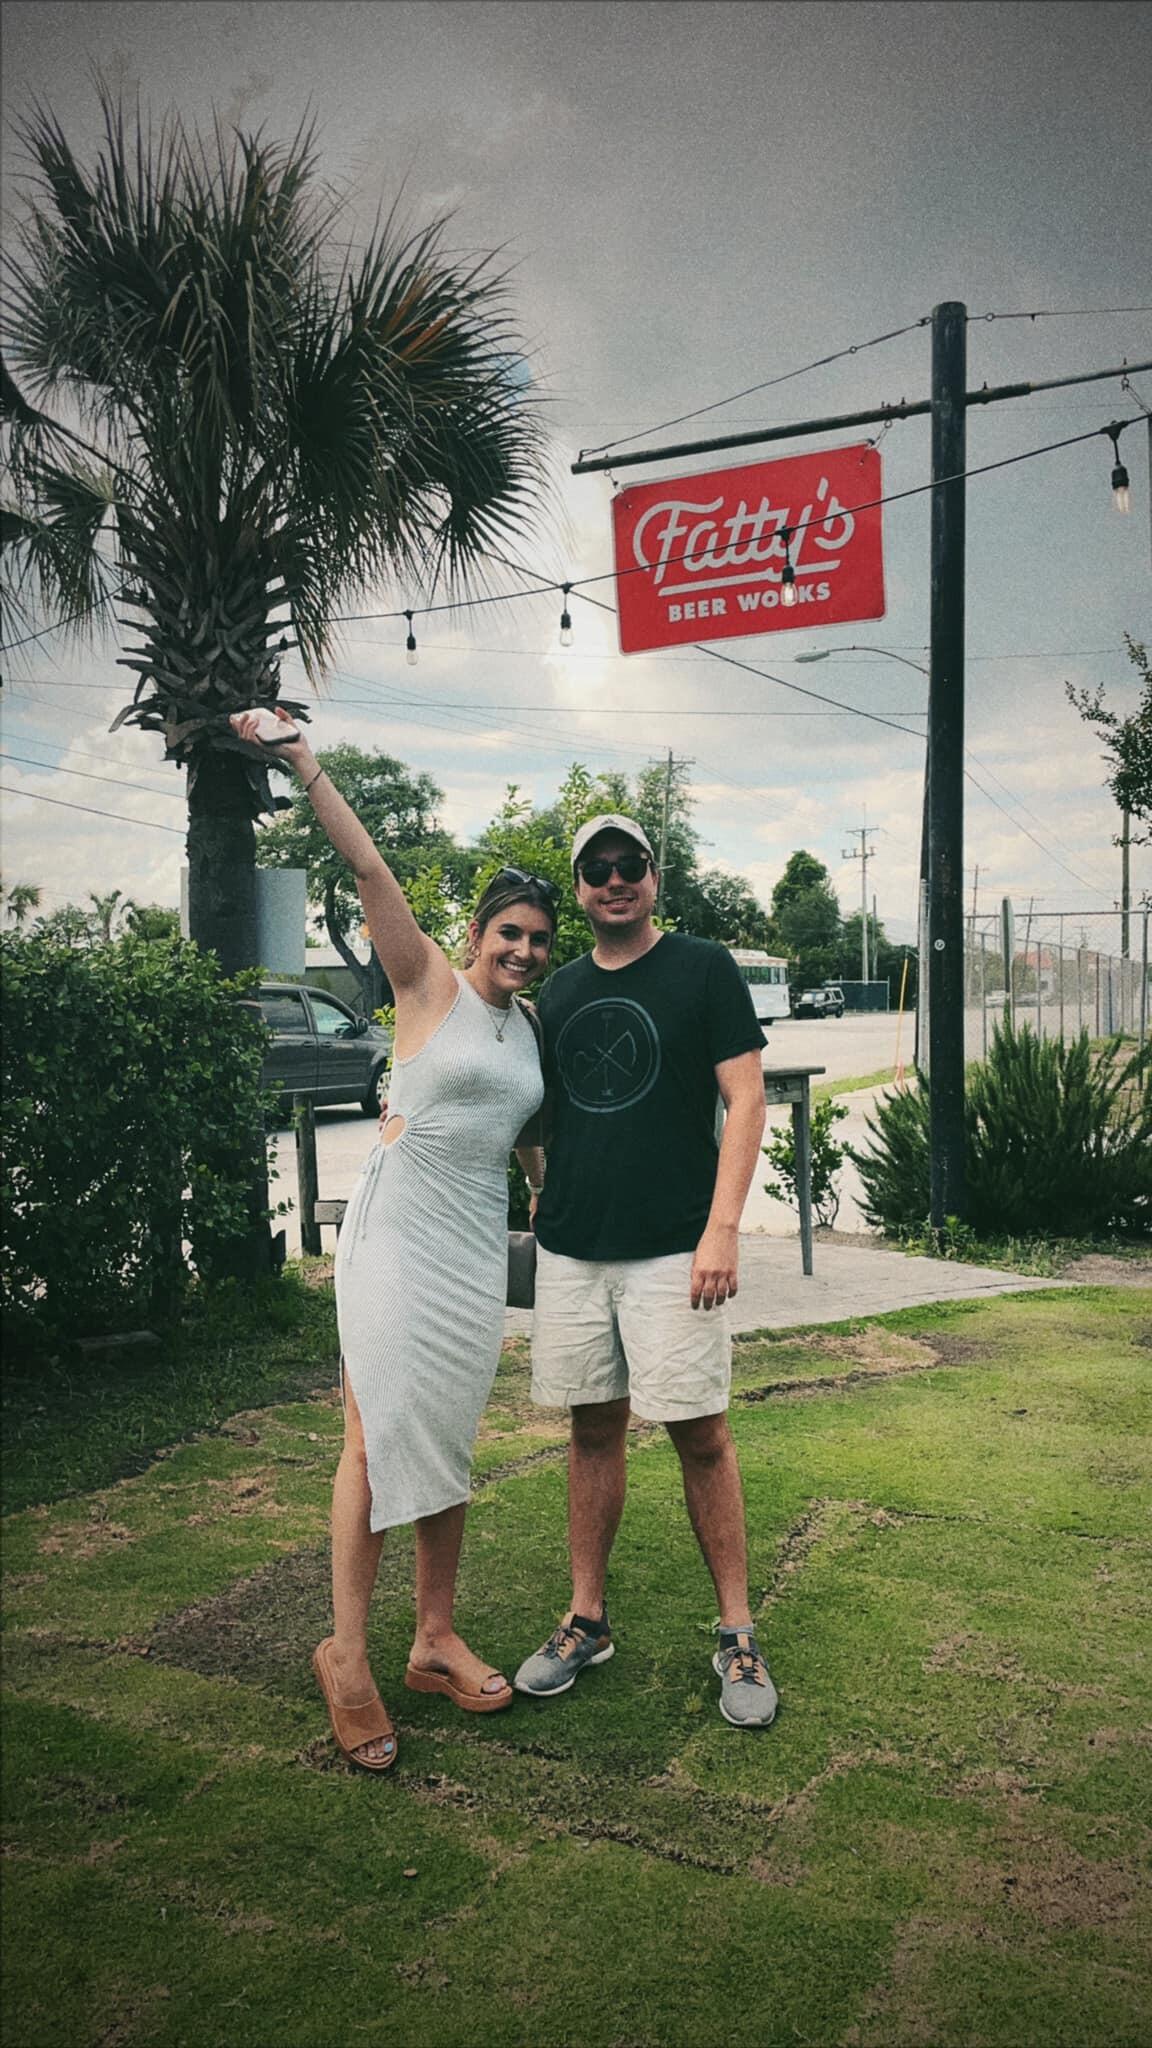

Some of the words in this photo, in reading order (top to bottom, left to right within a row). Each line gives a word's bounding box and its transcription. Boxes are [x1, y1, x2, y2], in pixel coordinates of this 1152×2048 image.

[633, 477, 855, 585] Fatty's
[668, 599, 727, 623] BEER
[736, 582, 831, 612] WOKS
